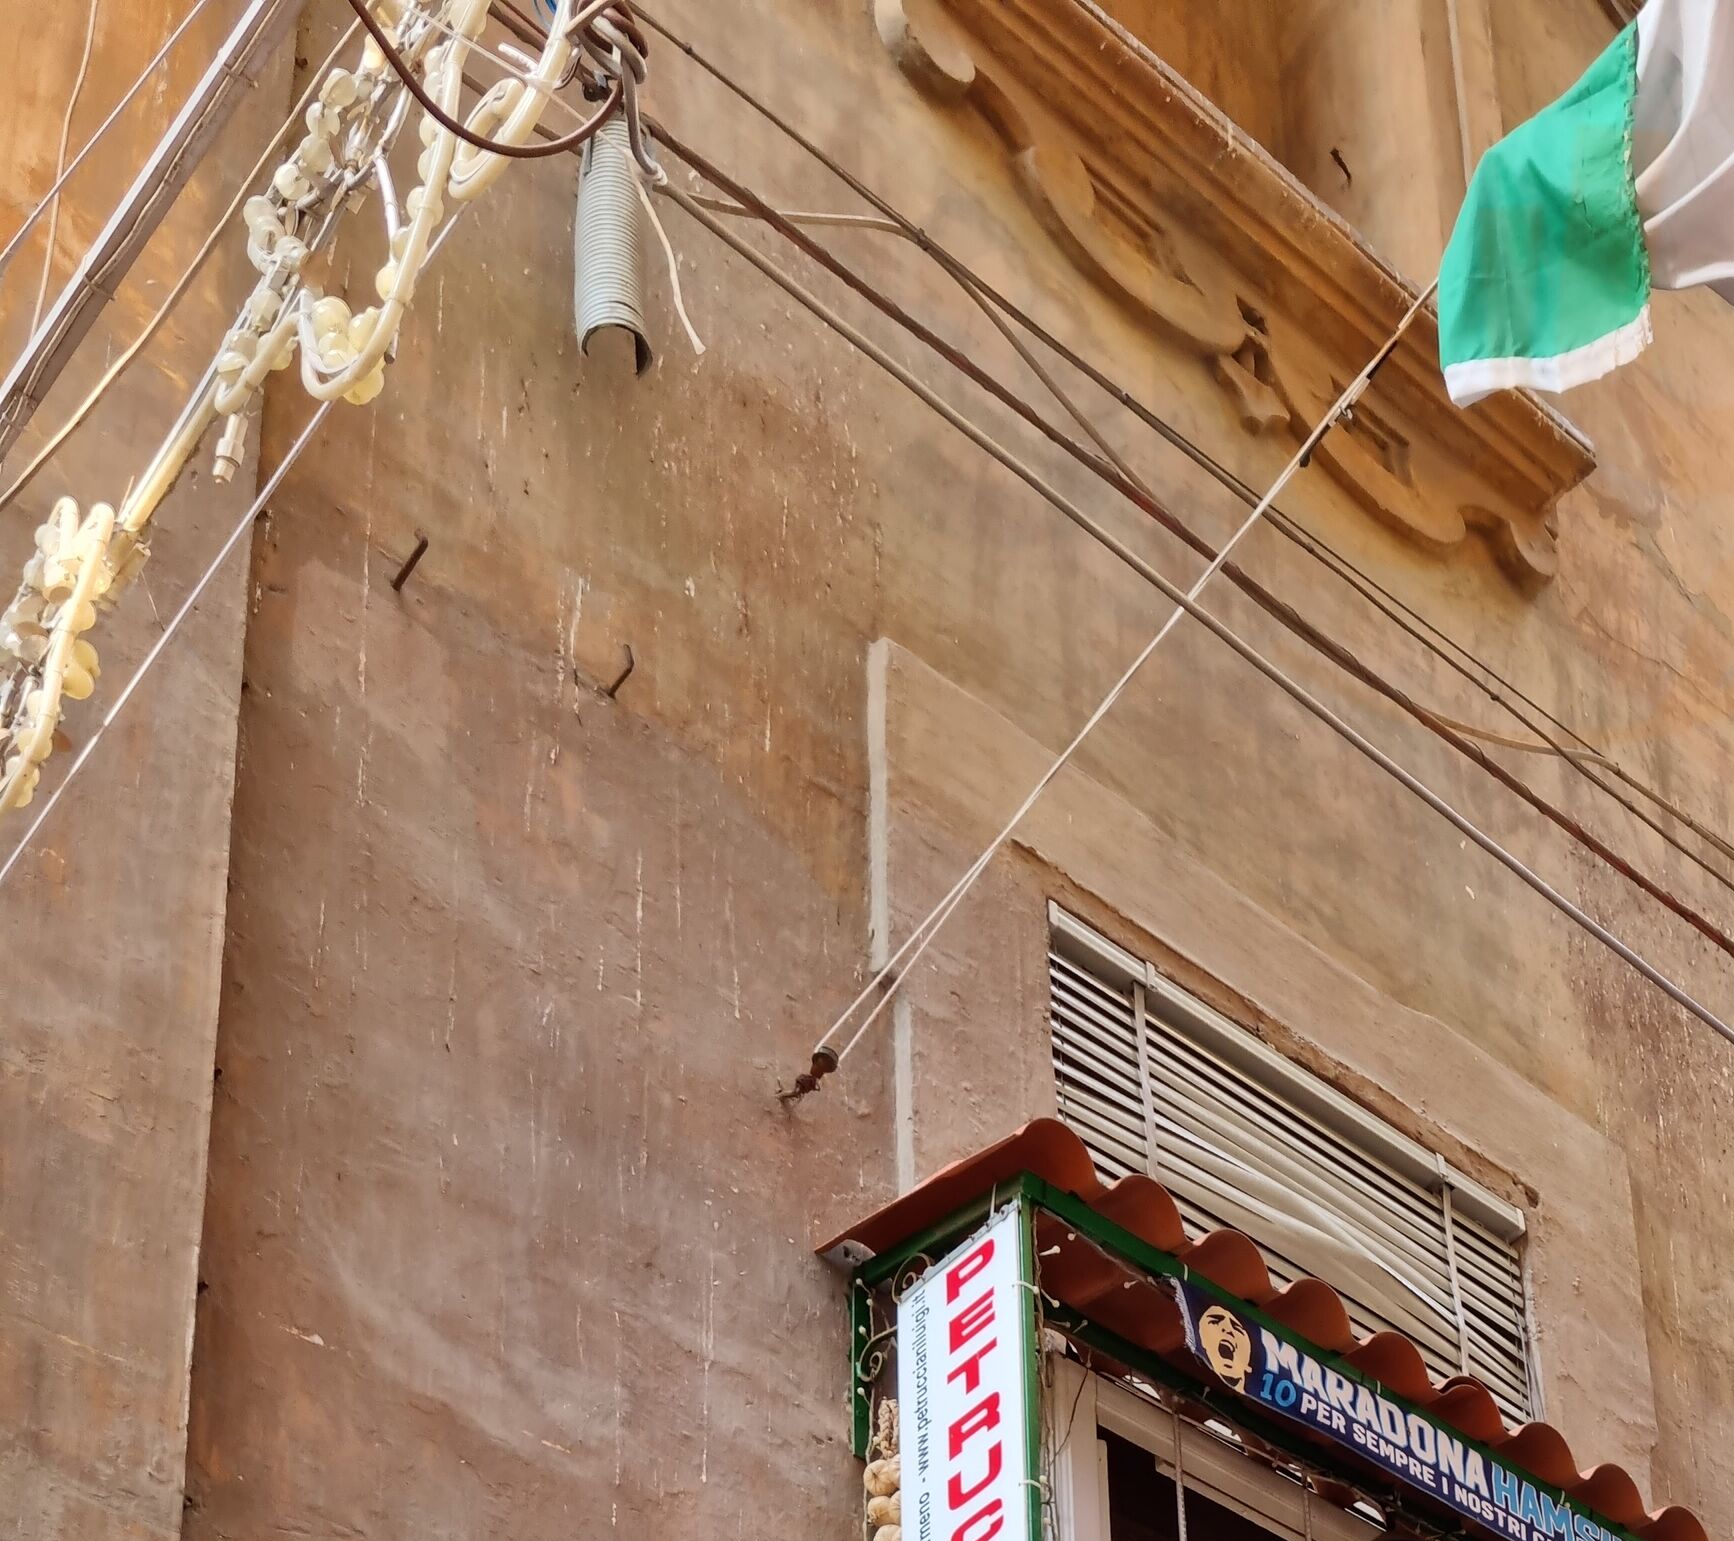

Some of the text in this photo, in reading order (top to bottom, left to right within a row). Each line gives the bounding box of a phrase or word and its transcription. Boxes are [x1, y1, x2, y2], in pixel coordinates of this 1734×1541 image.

[912, 1288, 933, 1477] www.petruccianiluigi.it
[1260, 1325, 1490, 1497] MARADONA
[1260, 1372, 1297, 1408] 10
[1300, 1392, 1347, 1435] PER
[1352, 1420, 1437, 1490] SEMPRE
[1441, 1475, 1449, 1495] I
[1455, 1481, 1528, 1541] NOSTRI
